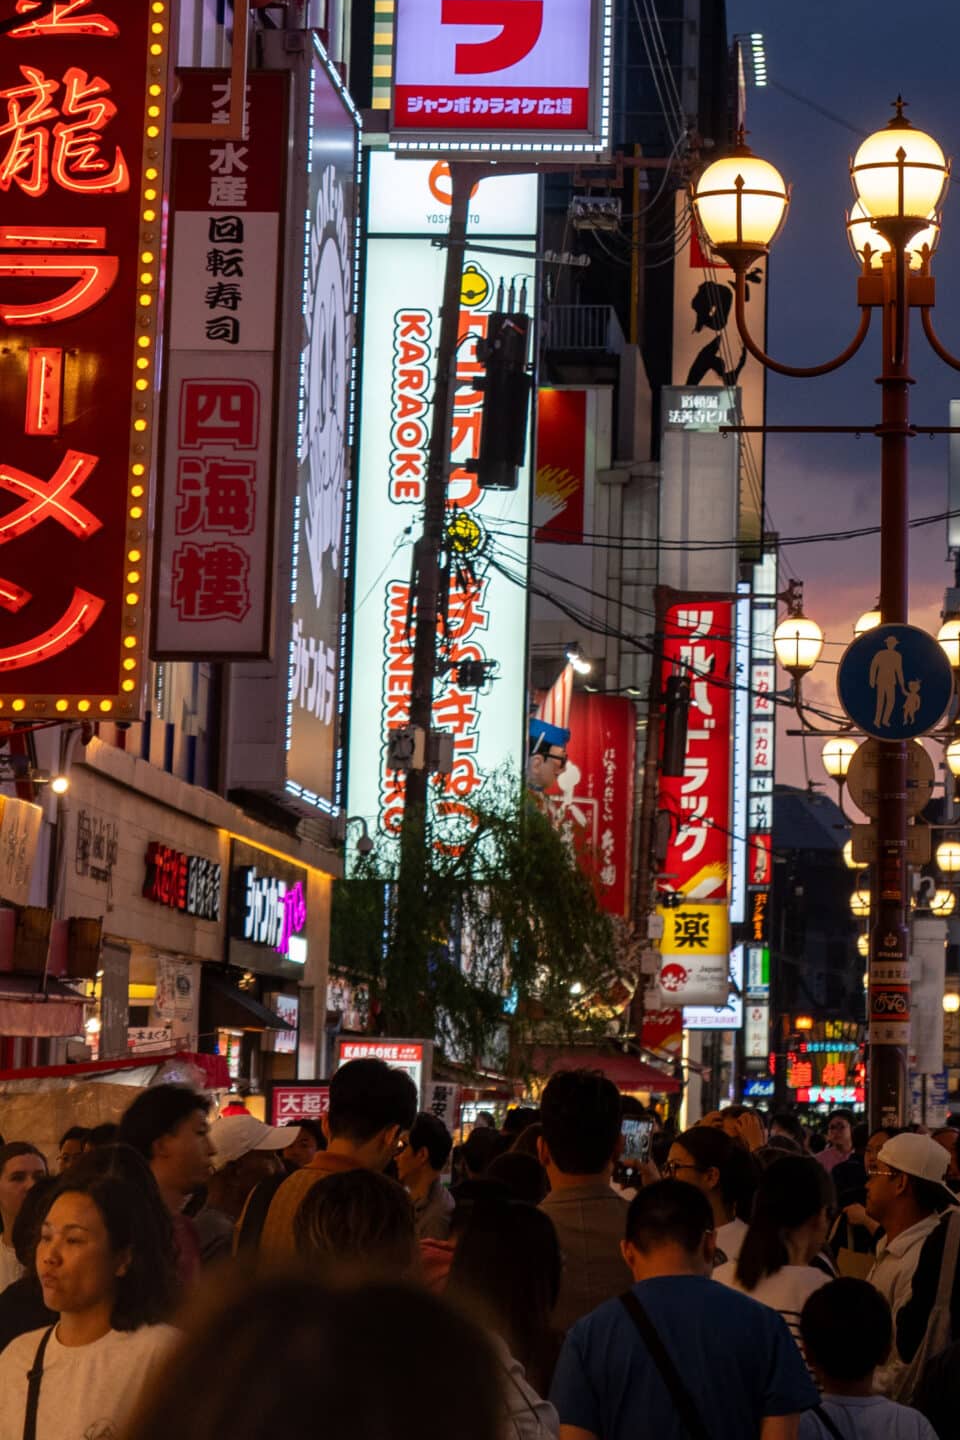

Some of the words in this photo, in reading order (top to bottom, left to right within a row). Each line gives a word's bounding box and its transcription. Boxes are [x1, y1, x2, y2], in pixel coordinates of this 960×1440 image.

[407, 95, 573, 115] ジャンボカラオケ広場
[426, 214, 480, 224] YOSHTO
[204, 215, 244, 345] 回転寿司
[394, 314, 426, 499] KARAOKE
[384, 585, 414, 833] MANEKIKO
[674, 912, 710, 948] 薬
[344, 1047, 398, 1059] KARAOKE
